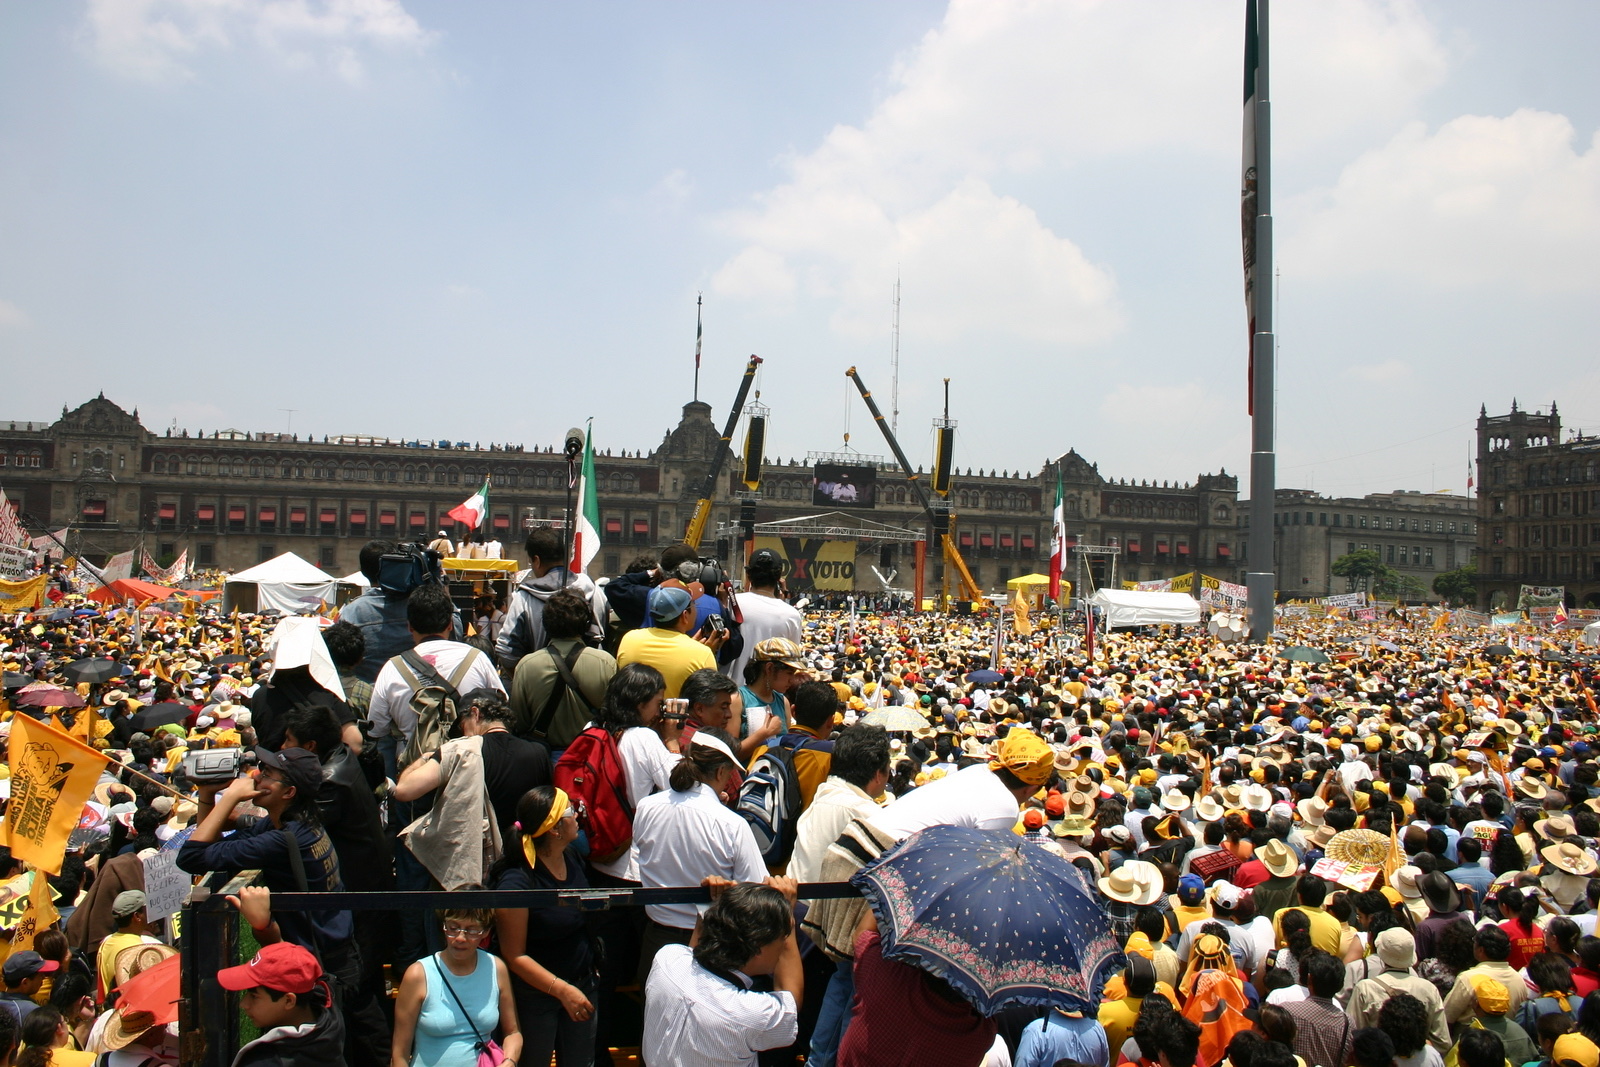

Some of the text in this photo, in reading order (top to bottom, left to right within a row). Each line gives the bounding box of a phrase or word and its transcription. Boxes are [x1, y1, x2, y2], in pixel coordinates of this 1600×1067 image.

[813, 561, 855, 579] VOTO
[146, 853, 171, 870] VOTO
[147, 875, 180, 893] FELIPE
[162, 887, 186, 901] SEAS
